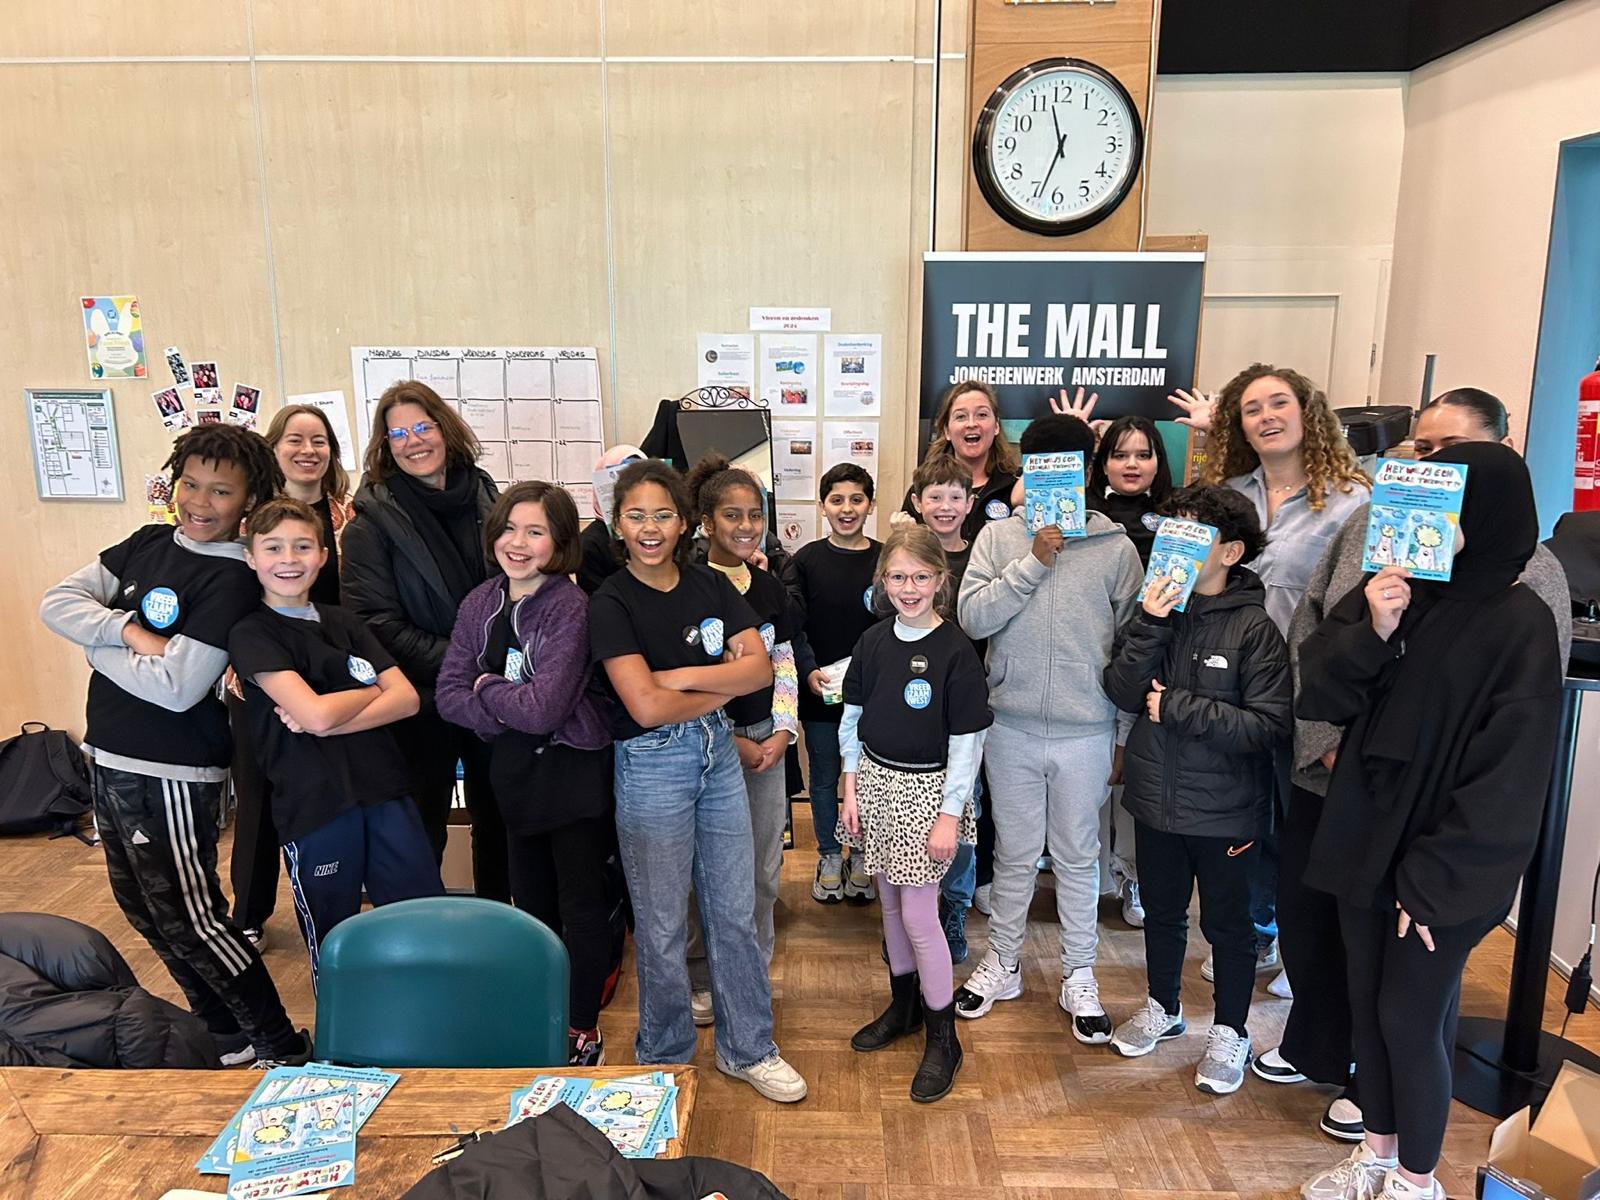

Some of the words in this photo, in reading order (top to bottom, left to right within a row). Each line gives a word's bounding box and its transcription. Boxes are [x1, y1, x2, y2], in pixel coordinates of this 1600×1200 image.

[1032, 95, 1048, 112] 11
[1053, 86, 1072, 104] 12
[1083, 93, 1089, 110] 1
[1014, 115, 1032, 132] 10
[1097, 109, 1108, 126] 2
[1004, 136, 1016, 156] 9
[1105, 136, 1117, 153] 3
[1010, 163, 1023, 180] 8
[1095, 160, 1108, 178] 4
[1031, 181, 1042, 198] 7
[1052, 186, 1064, 204] 6
[1079, 180, 1090, 198] 5
[952, 304, 1031, 358] THE
[1044, 304, 1168, 358] MALL
[950, 366, 1064, 385] JONGERENWERK
[1072, 367, 1166, 386] AMSTERDAM
[314, 861, 339, 876] NIKE
